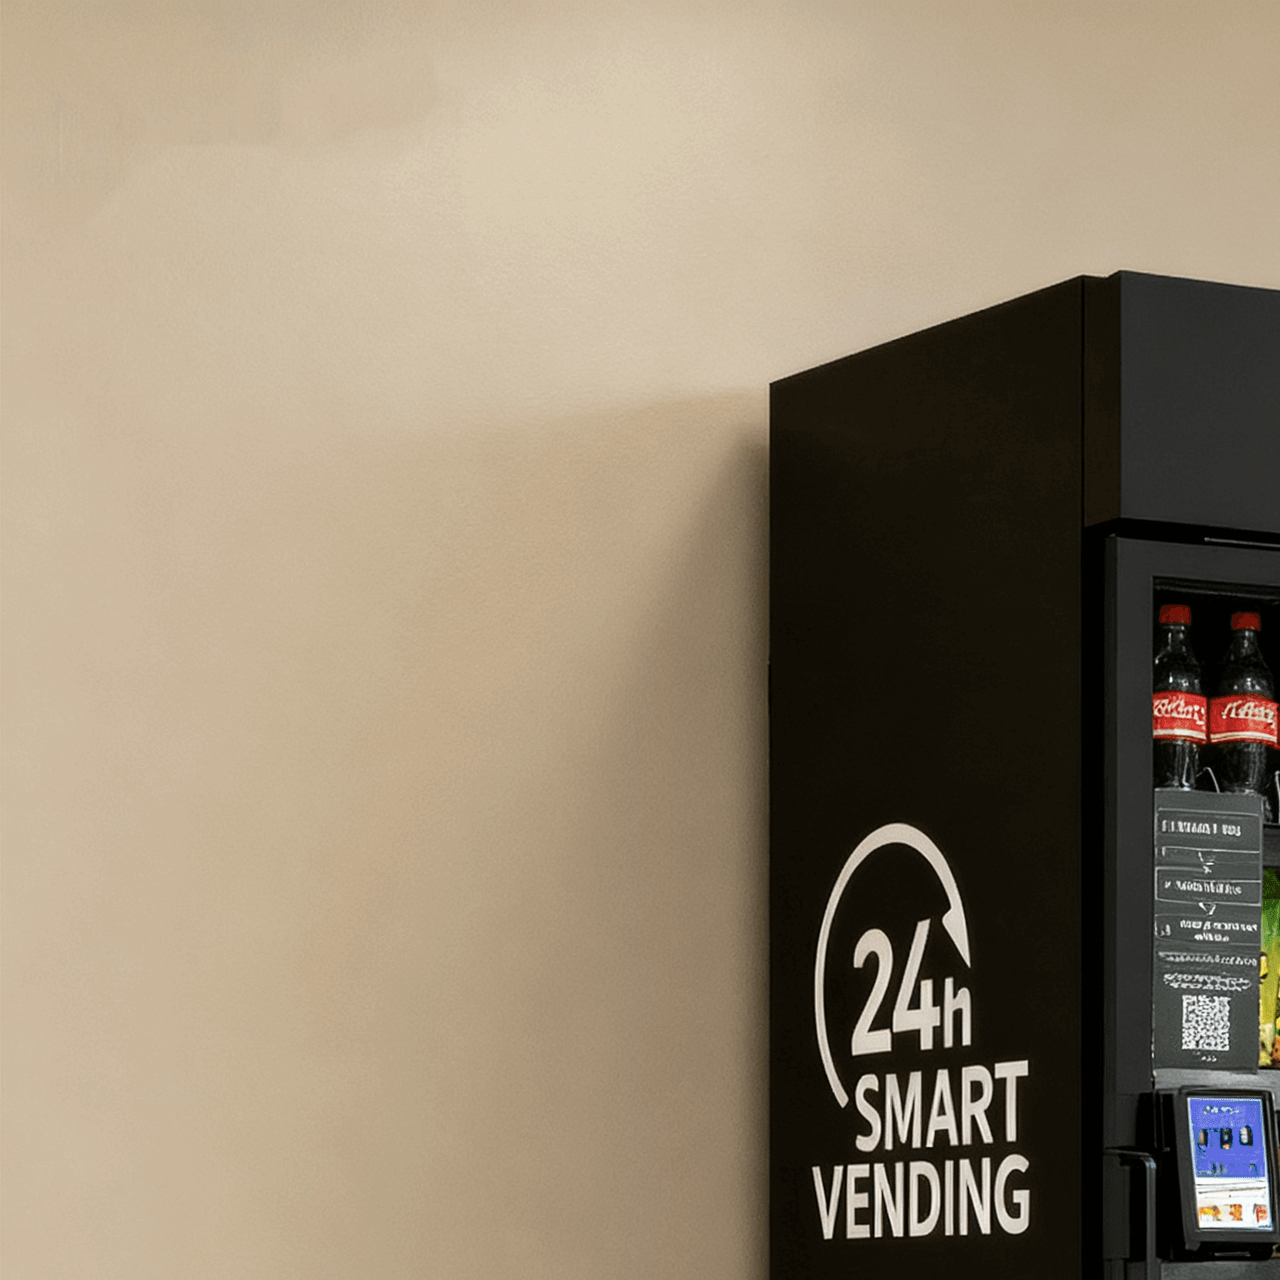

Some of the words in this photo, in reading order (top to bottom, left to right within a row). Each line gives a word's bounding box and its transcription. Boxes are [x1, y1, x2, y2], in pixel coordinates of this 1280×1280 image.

[851, 918, 972, 1056] 24h
[855, 1060, 1029, 1152] SMART
[811, 1153, 1030, 1240] VENDING
